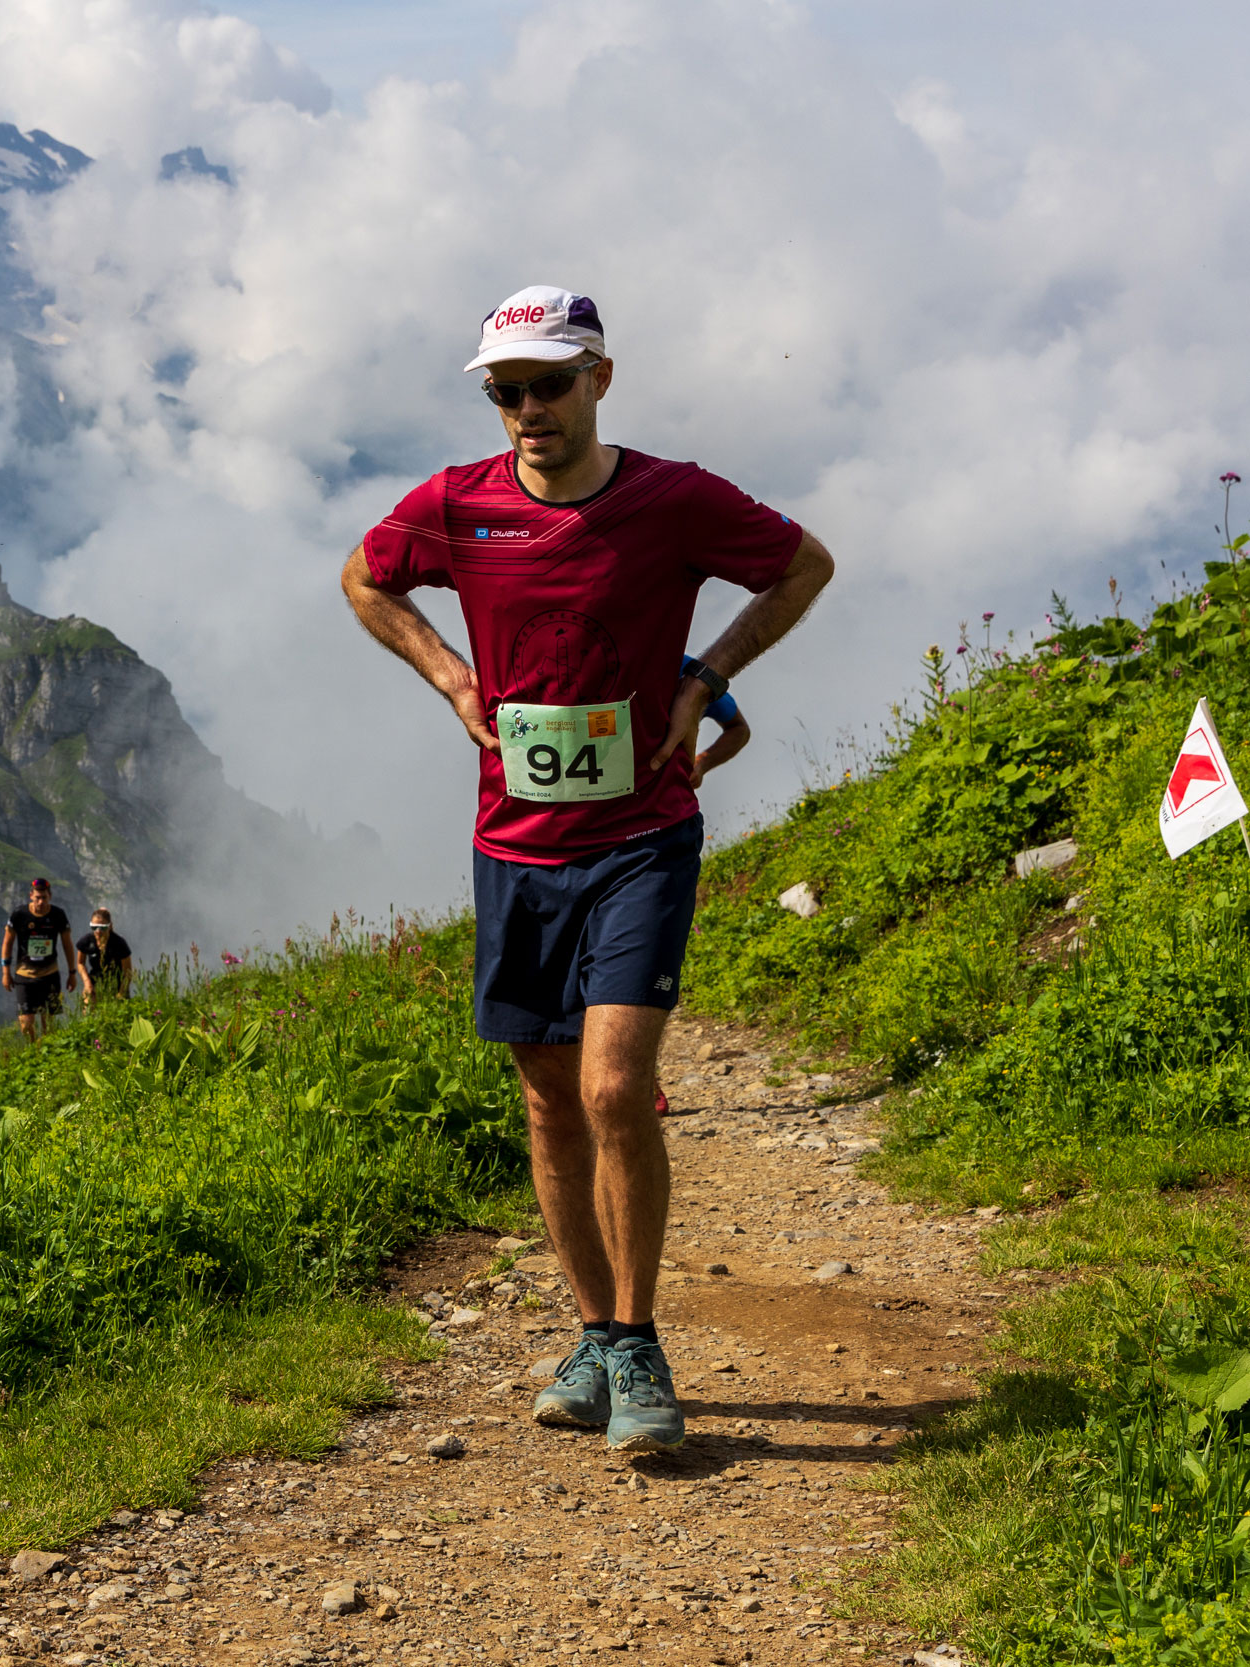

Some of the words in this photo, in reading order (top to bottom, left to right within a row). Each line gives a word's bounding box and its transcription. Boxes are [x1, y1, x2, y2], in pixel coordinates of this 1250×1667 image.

[495, 305, 545, 330] ciele
[499, 325, 536, 336] ATHLETICS
[546, 720, 577, 728] berglauf
[527, 744, 603, 786] 94
[34, 946, 47, 955] 72
